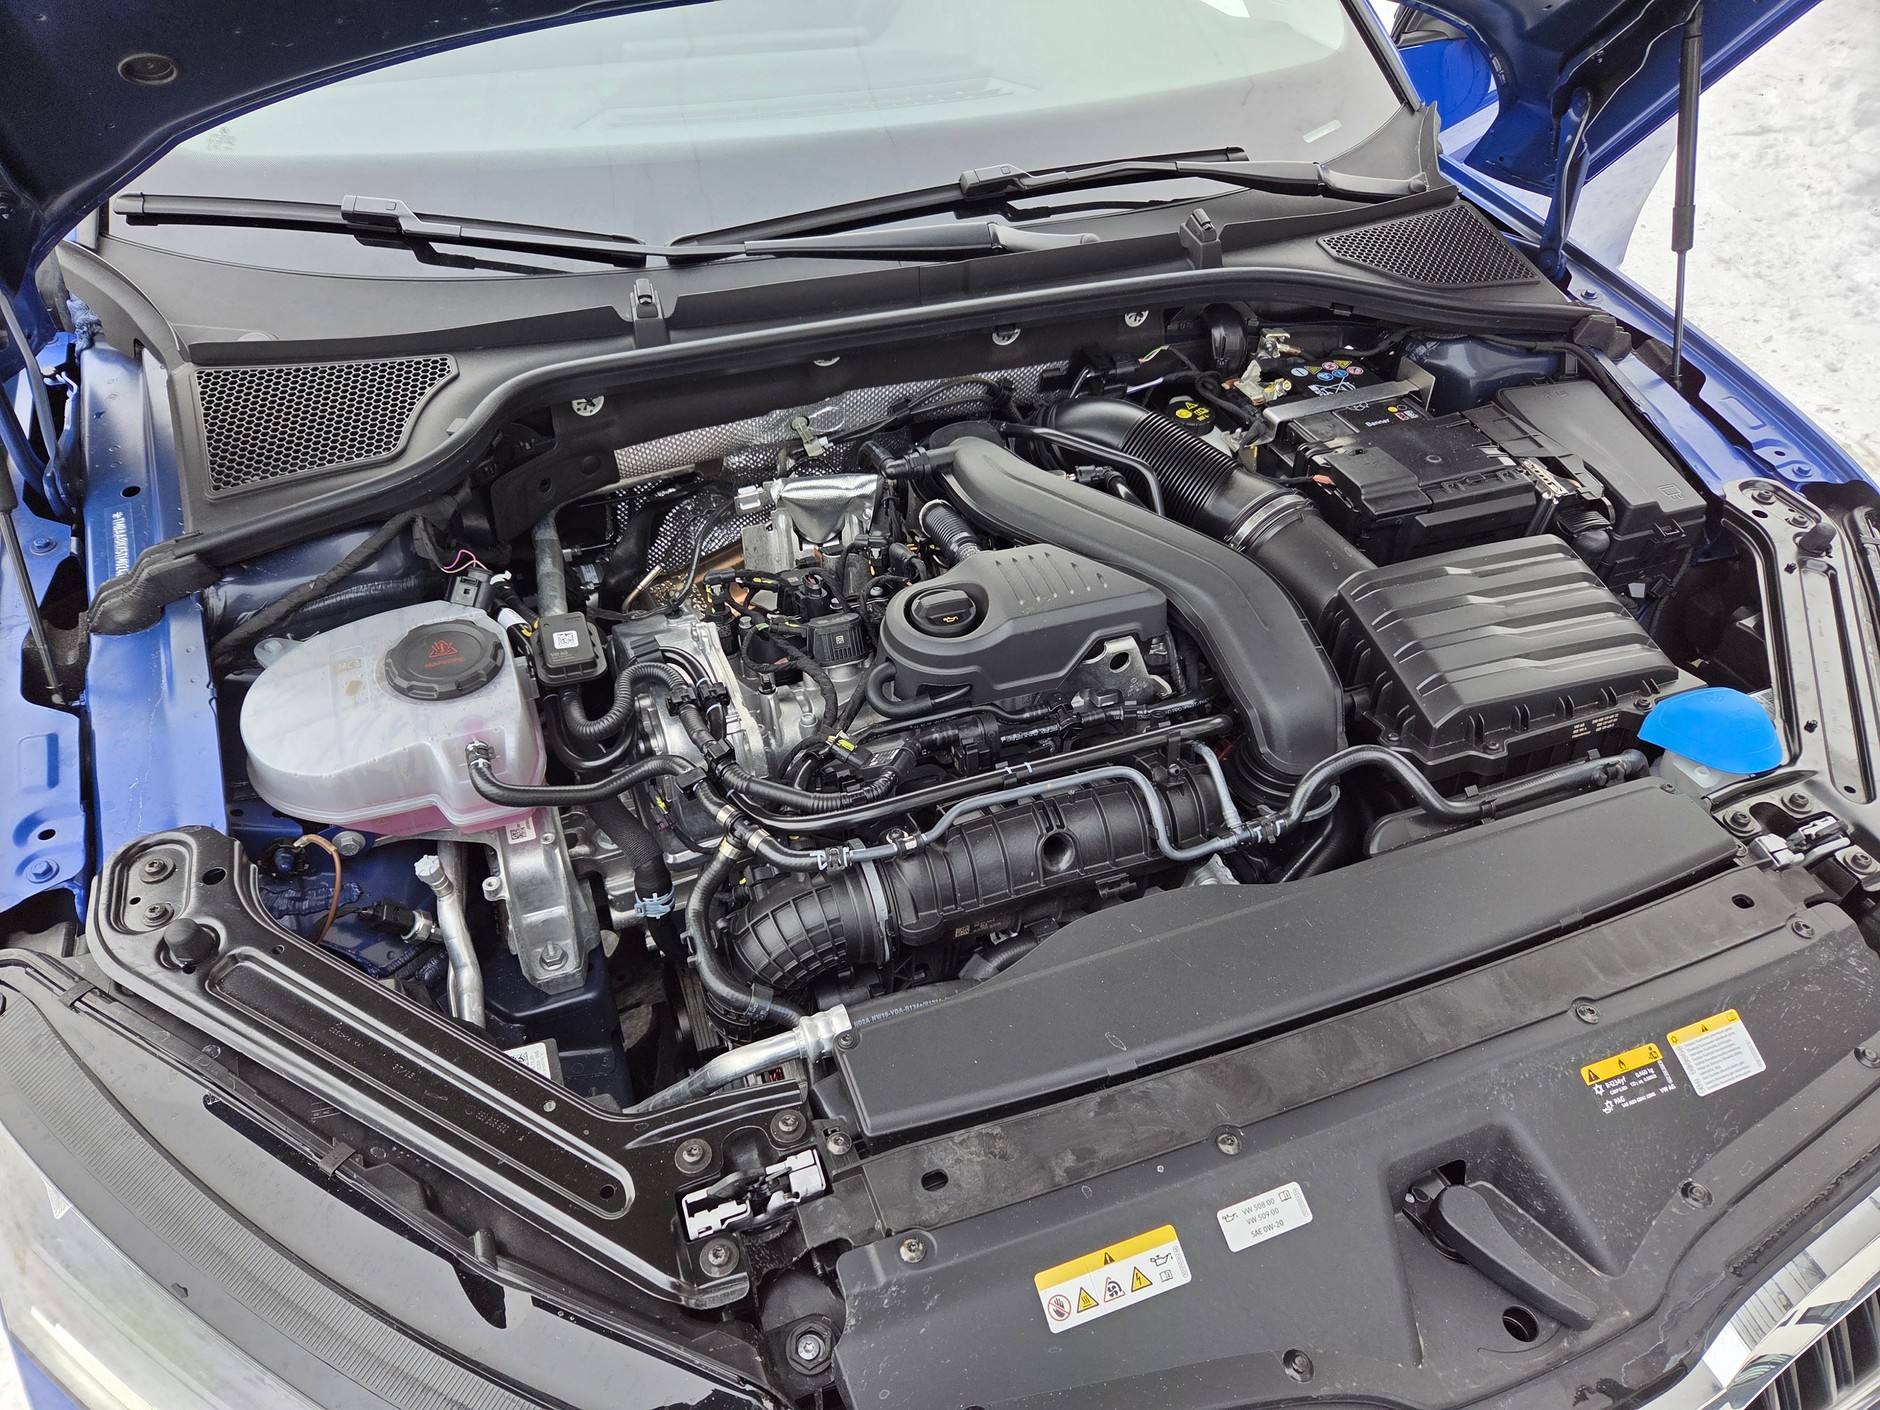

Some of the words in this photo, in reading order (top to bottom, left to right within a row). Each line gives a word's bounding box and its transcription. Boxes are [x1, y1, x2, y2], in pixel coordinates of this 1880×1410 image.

[1365, 418, 1390, 427] Banner
[1613, 1095, 1626, 1106] PAG
[1241, 1206, 1253, 1216] VW
[1253, 1201, 1267, 1212] 508
[1265, 1197, 1276, 1207] 00
[1245, 1216, 1257, 1225] VW
[1257, 1210, 1270, 1222] 509
[1270, 1207, 1280, 1216] 00
[1250, 1227, 1264, 1238] SAE
[1262, 1219, 1285, 1233] 0W-20
